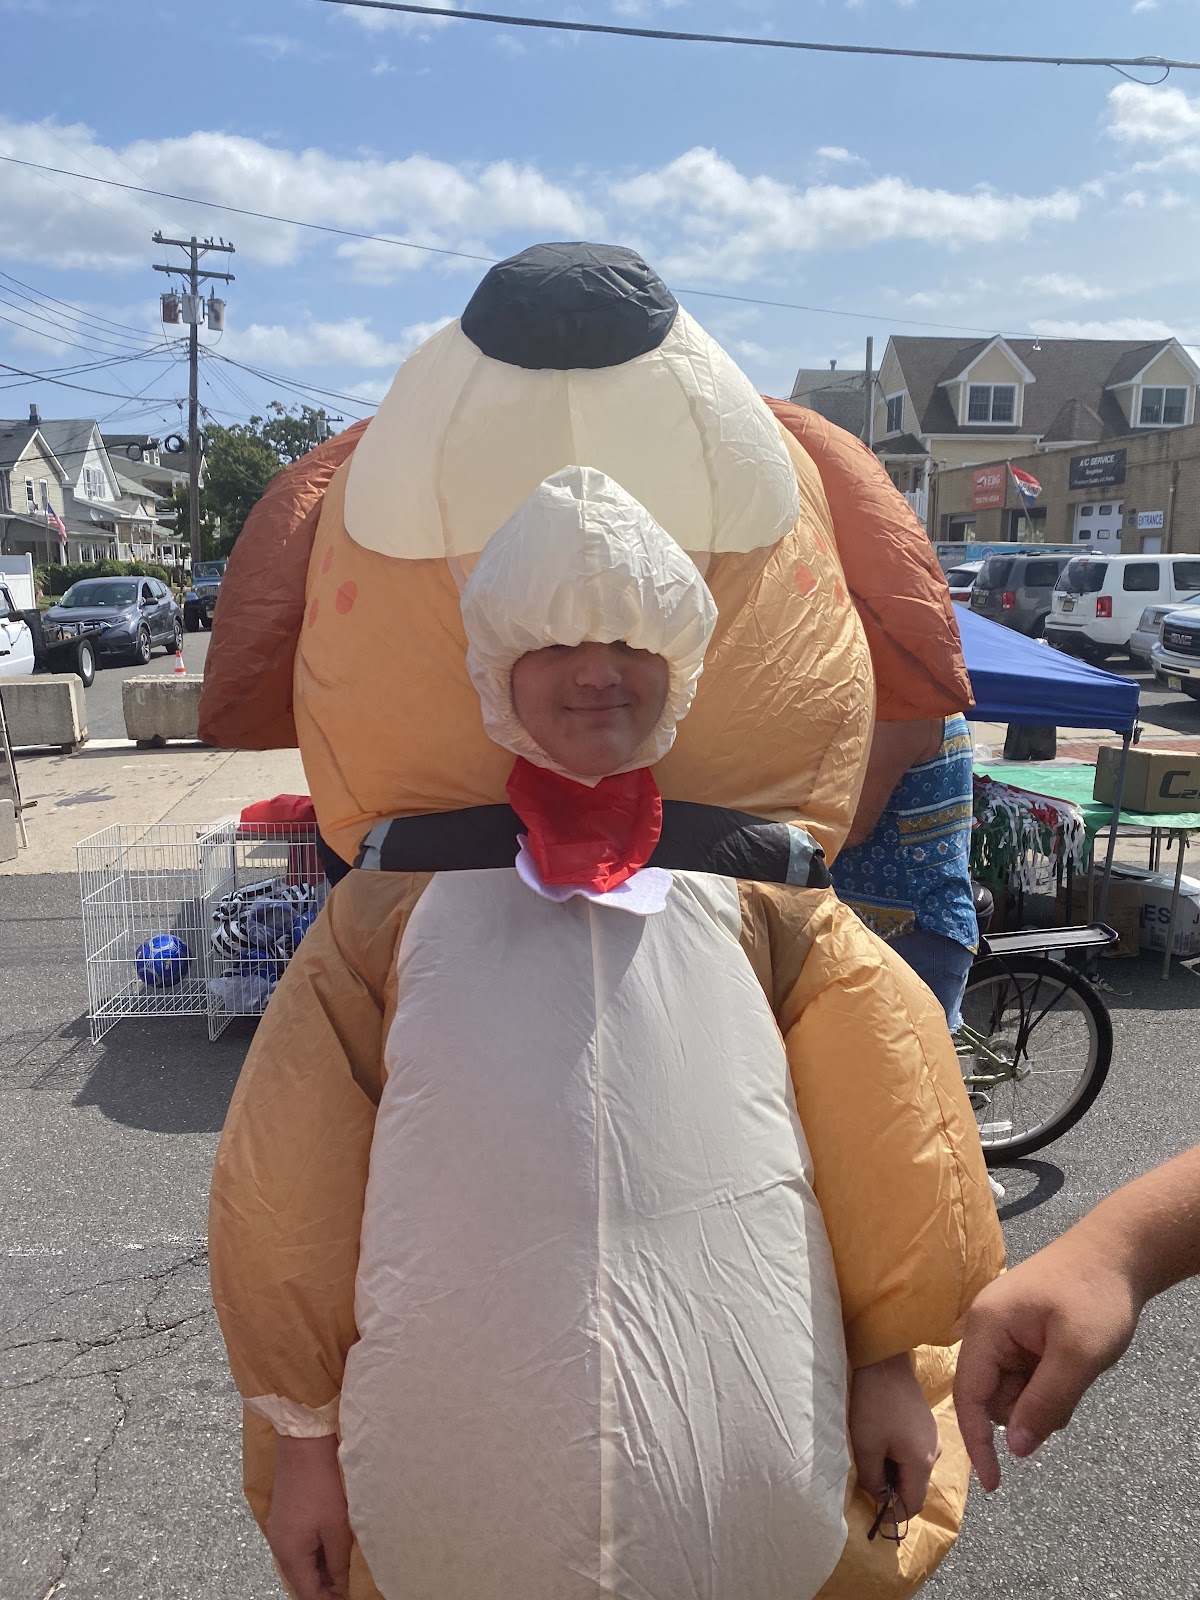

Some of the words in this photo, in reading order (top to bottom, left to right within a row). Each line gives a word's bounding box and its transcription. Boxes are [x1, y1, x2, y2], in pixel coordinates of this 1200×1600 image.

[1090, 455, 1115, 466] SERVICE
[1138, 514, 1162, 526] ENTRANCE
[1170, 632, 1192, 646] GMC
